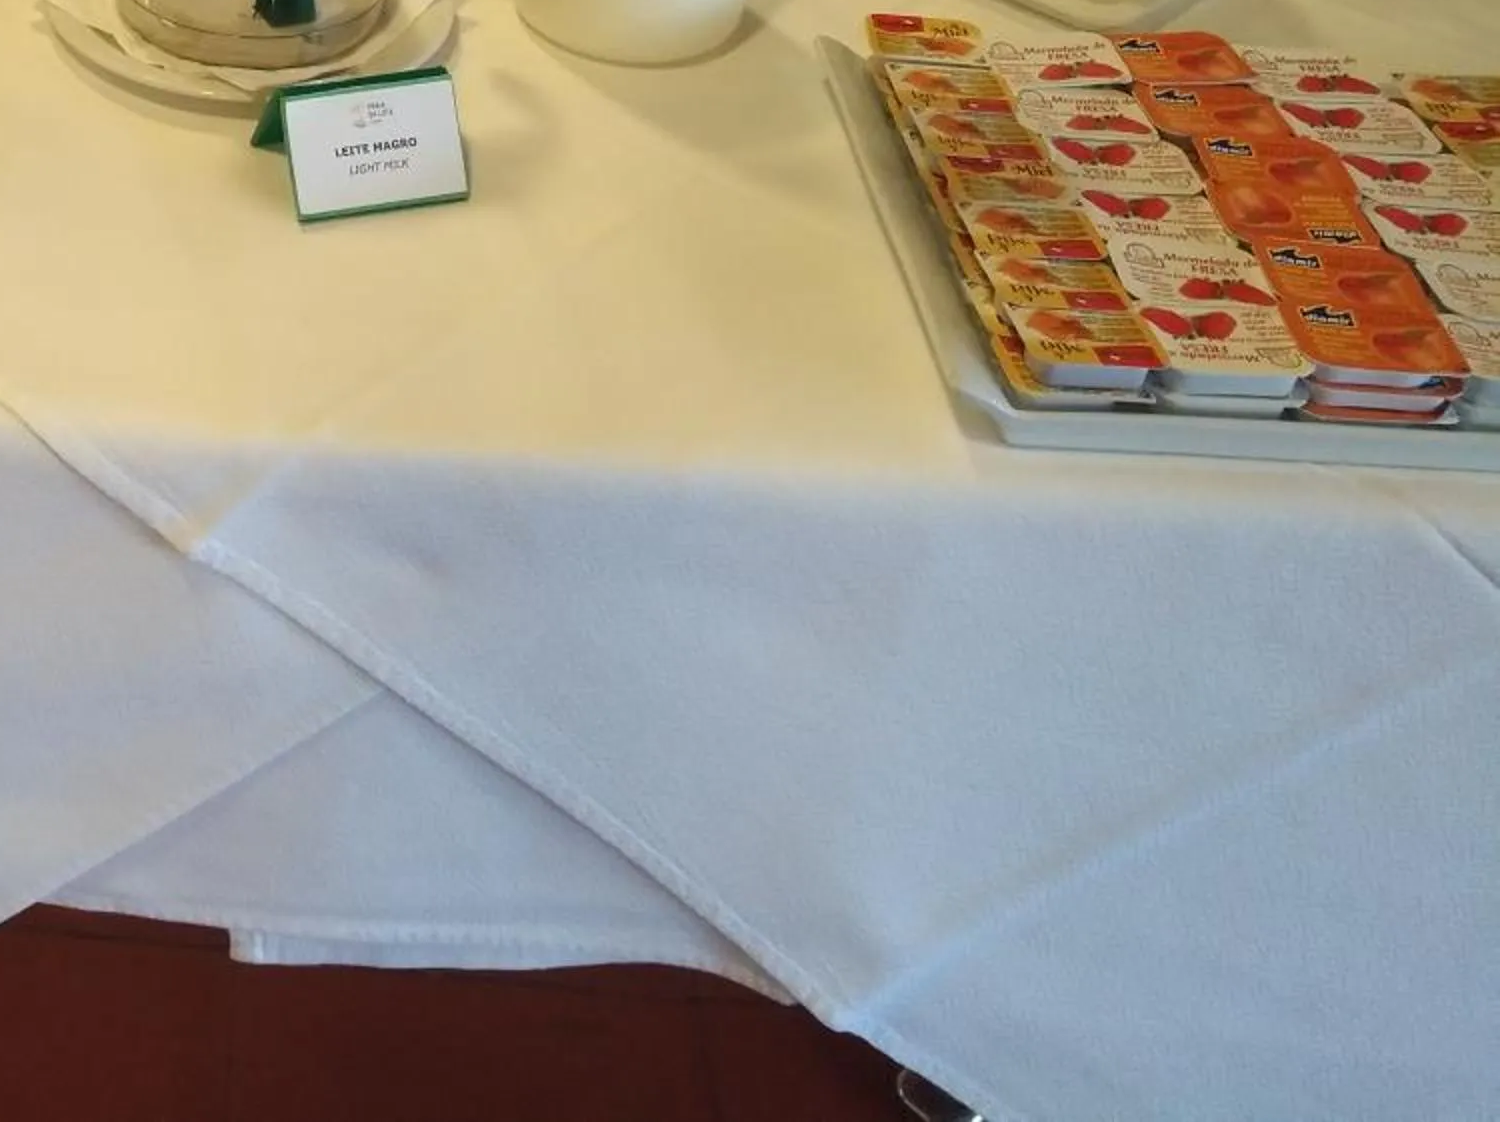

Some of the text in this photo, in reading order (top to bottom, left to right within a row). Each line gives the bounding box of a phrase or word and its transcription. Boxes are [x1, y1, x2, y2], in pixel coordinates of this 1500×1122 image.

[335, 137, 417, 158] LEITE MAGRO
[349, 159, 409, 175] LIGHT MILK
